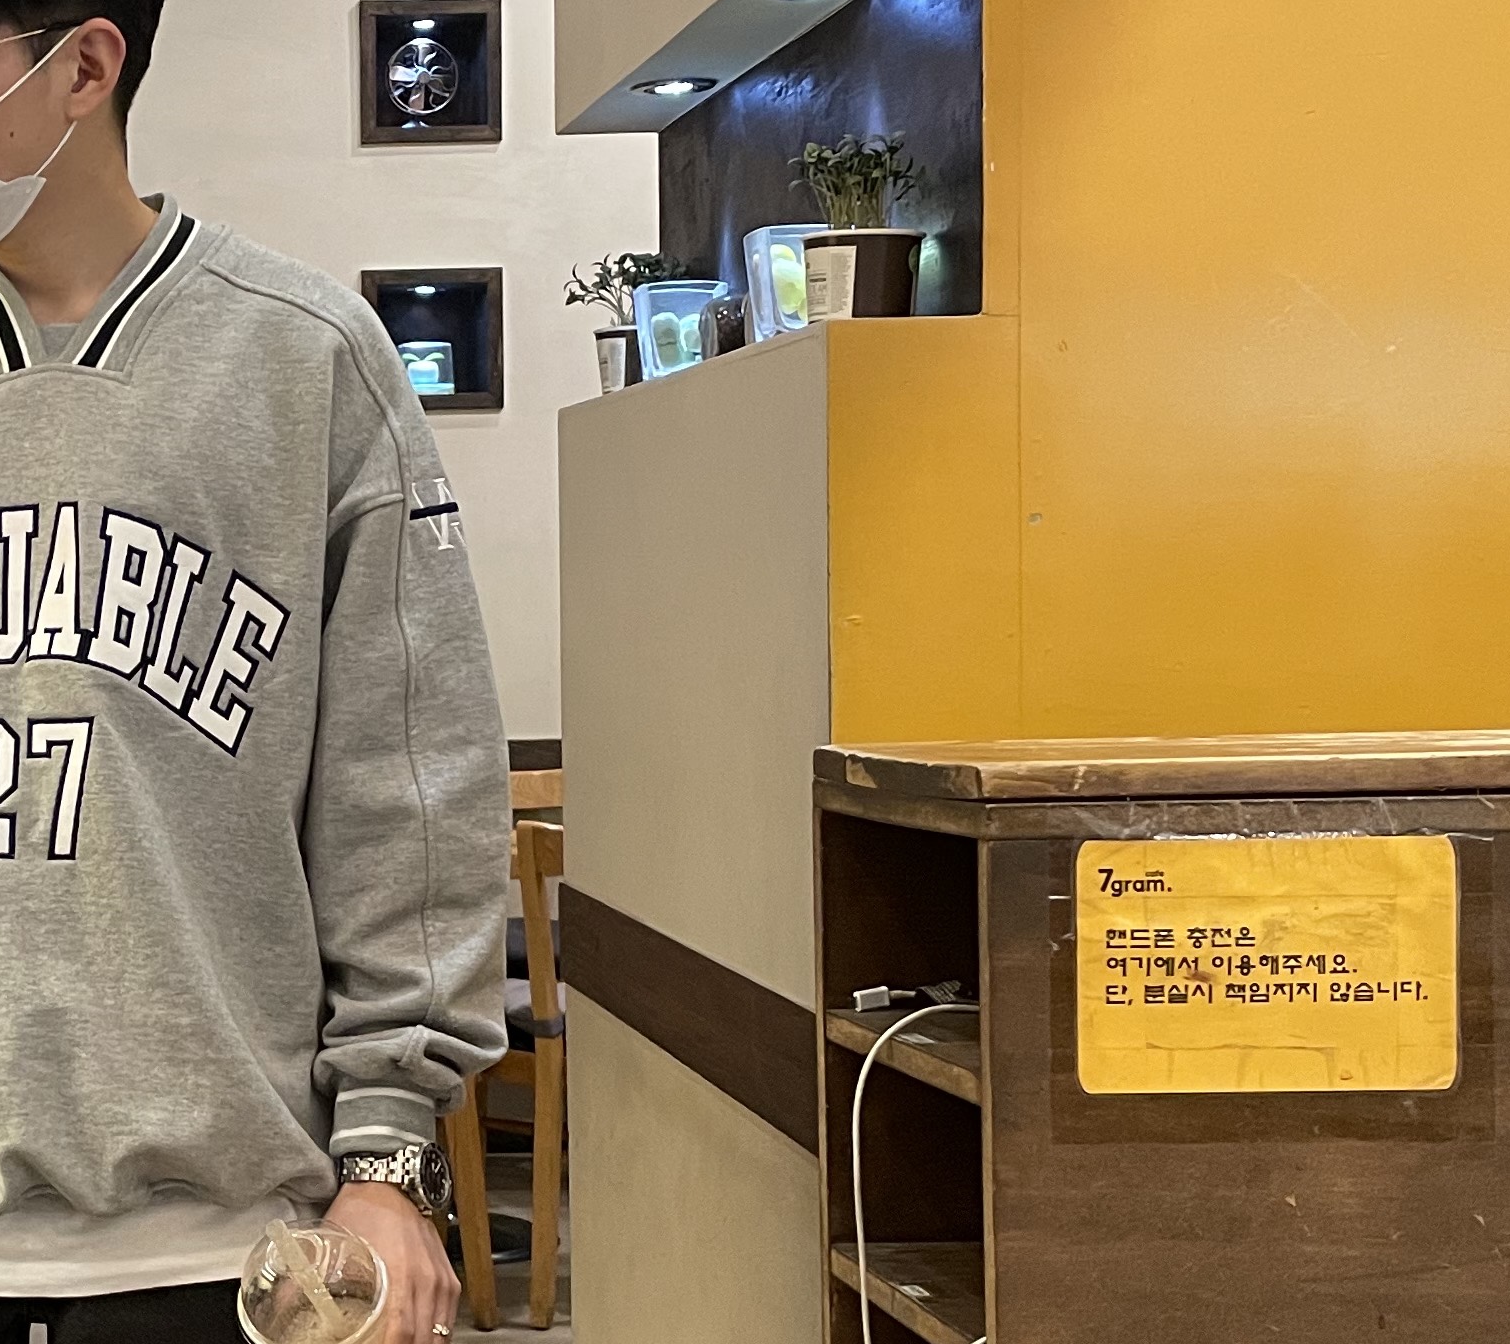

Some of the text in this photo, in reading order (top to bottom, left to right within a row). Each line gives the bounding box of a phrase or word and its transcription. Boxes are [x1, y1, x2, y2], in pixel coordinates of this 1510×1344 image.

[1105, 927, 1256, 950] 핸드폰 충전은
[1106, 954, 1358, 978] 여기에서 이용해주세요.
[1105, 981, 1429, 1007] 단, 분실시 책임지지 않습니다.
